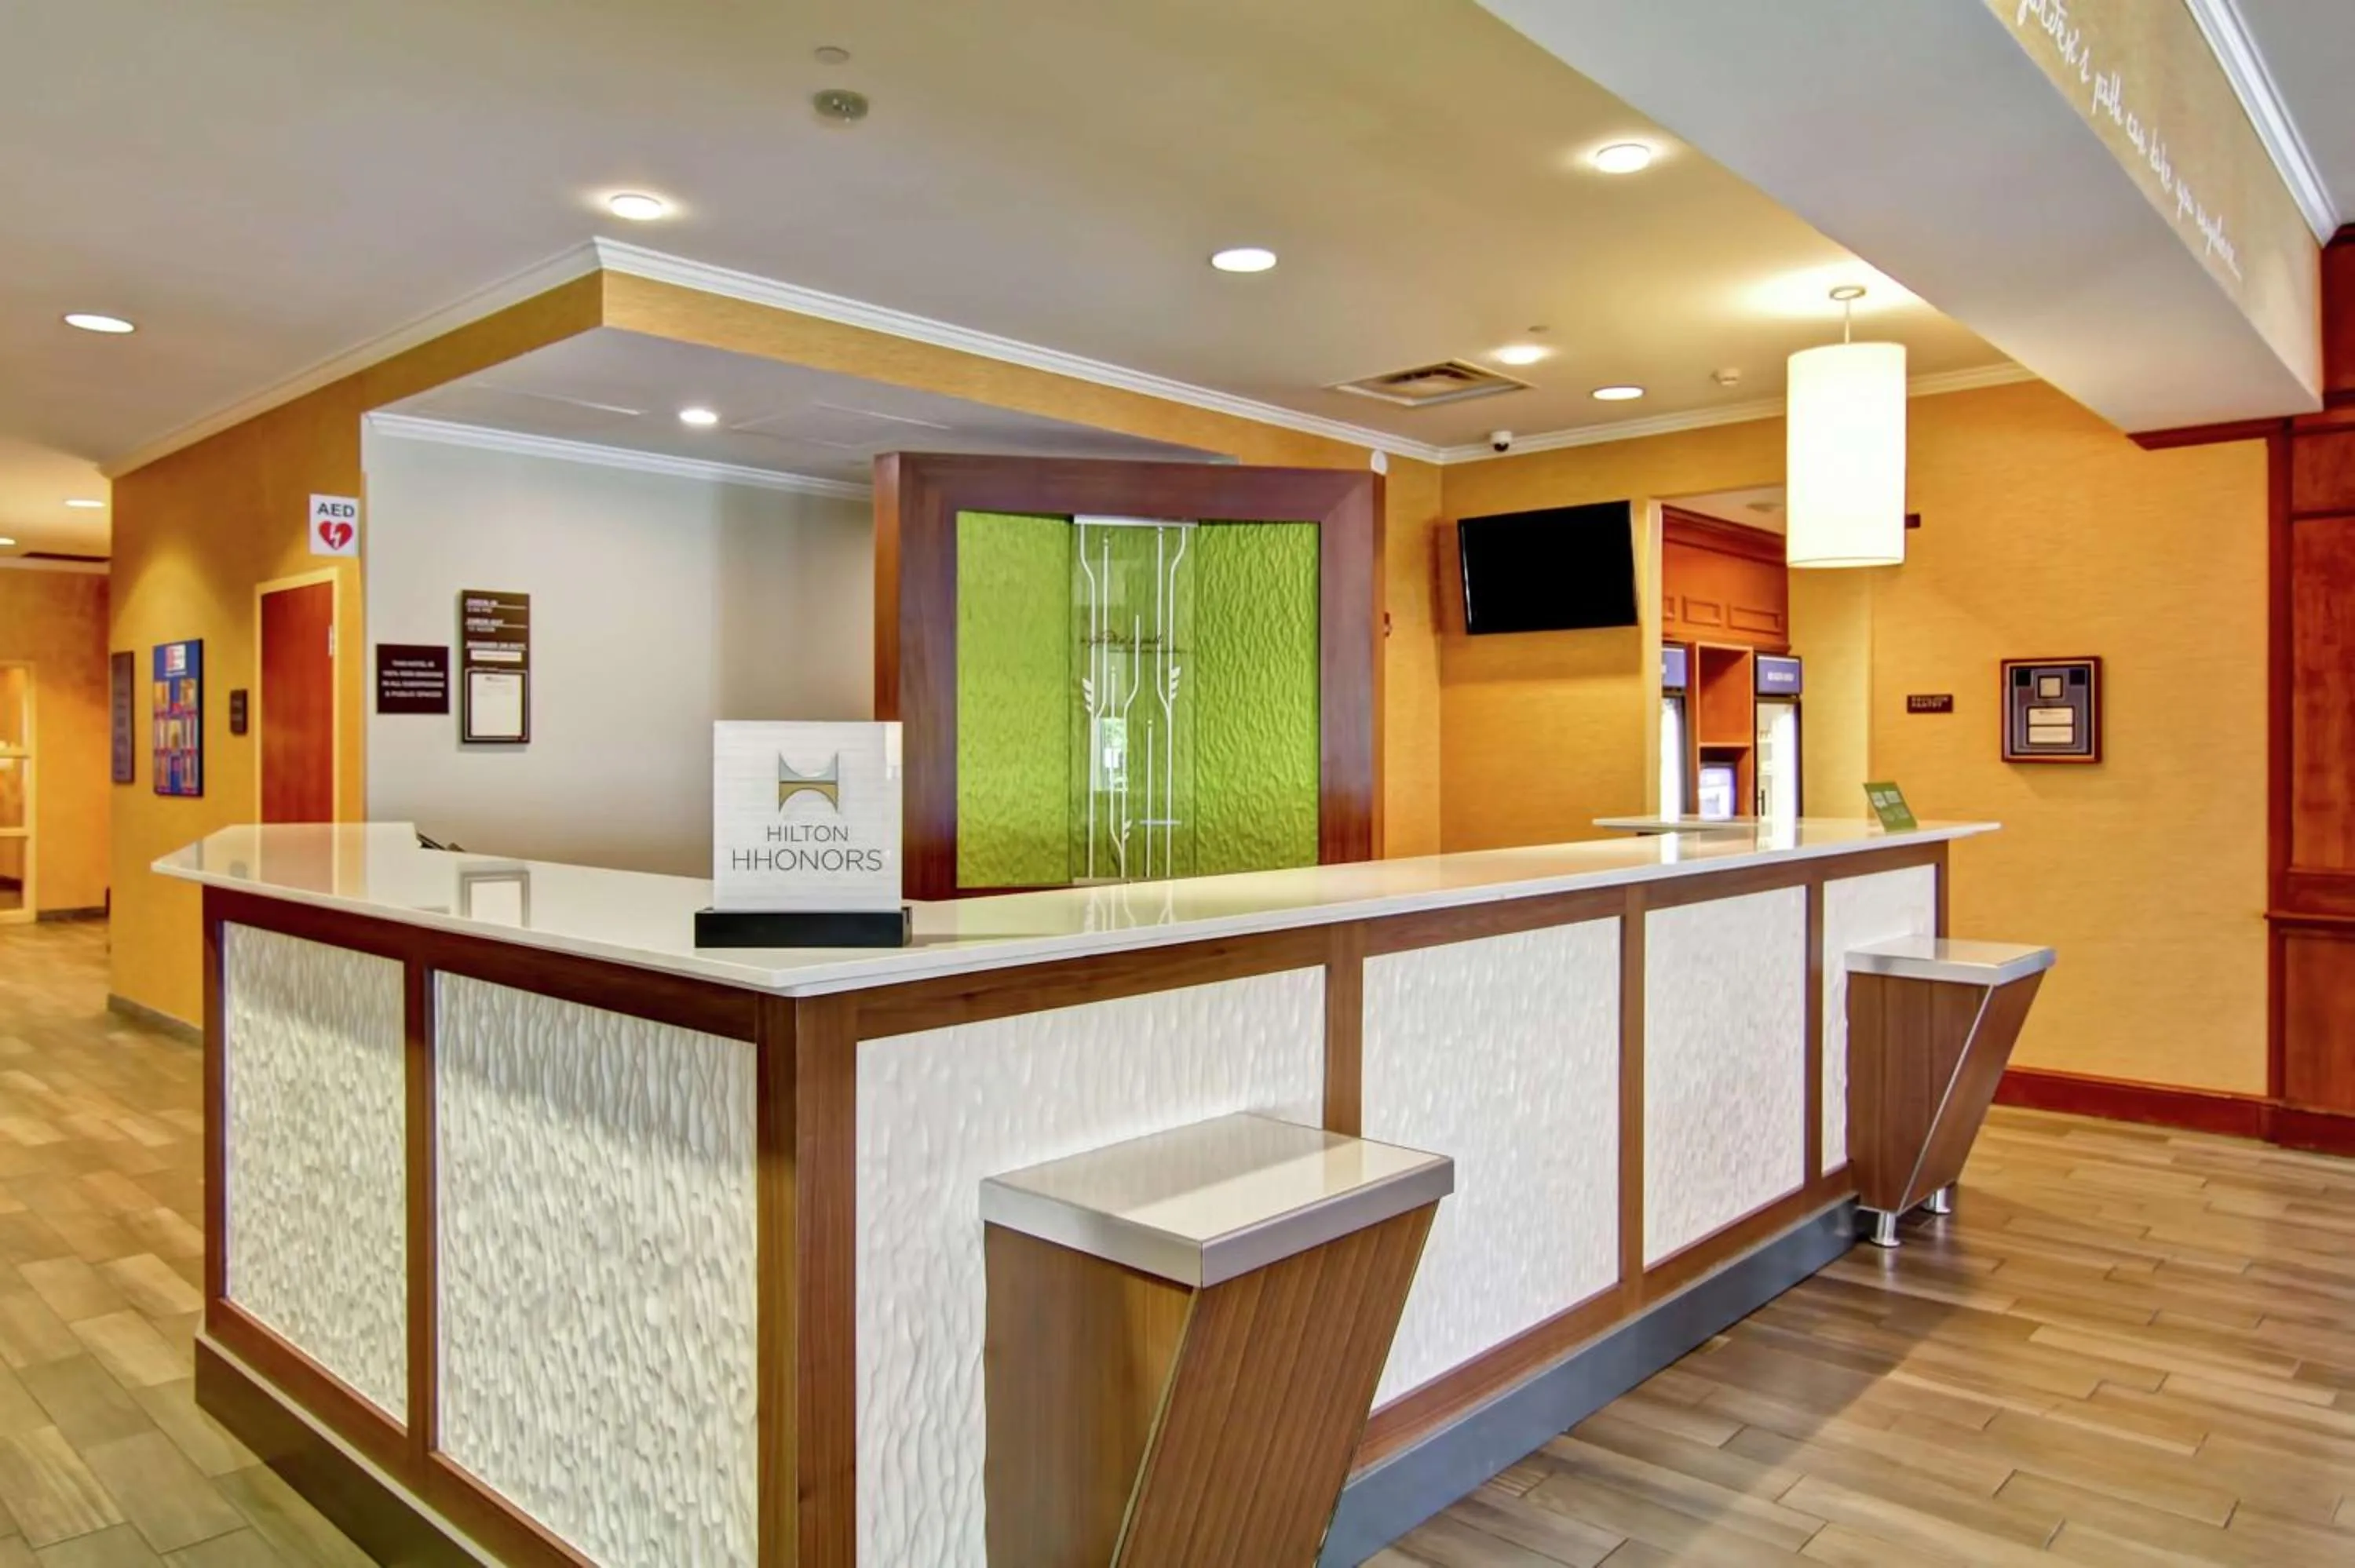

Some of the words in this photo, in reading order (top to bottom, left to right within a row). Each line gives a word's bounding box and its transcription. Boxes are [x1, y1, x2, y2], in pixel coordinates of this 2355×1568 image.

[316, 502, 355, 518] AED
[766, 825, 849, 842] HILTON
[732, 849, 882, 871] HHONORS
